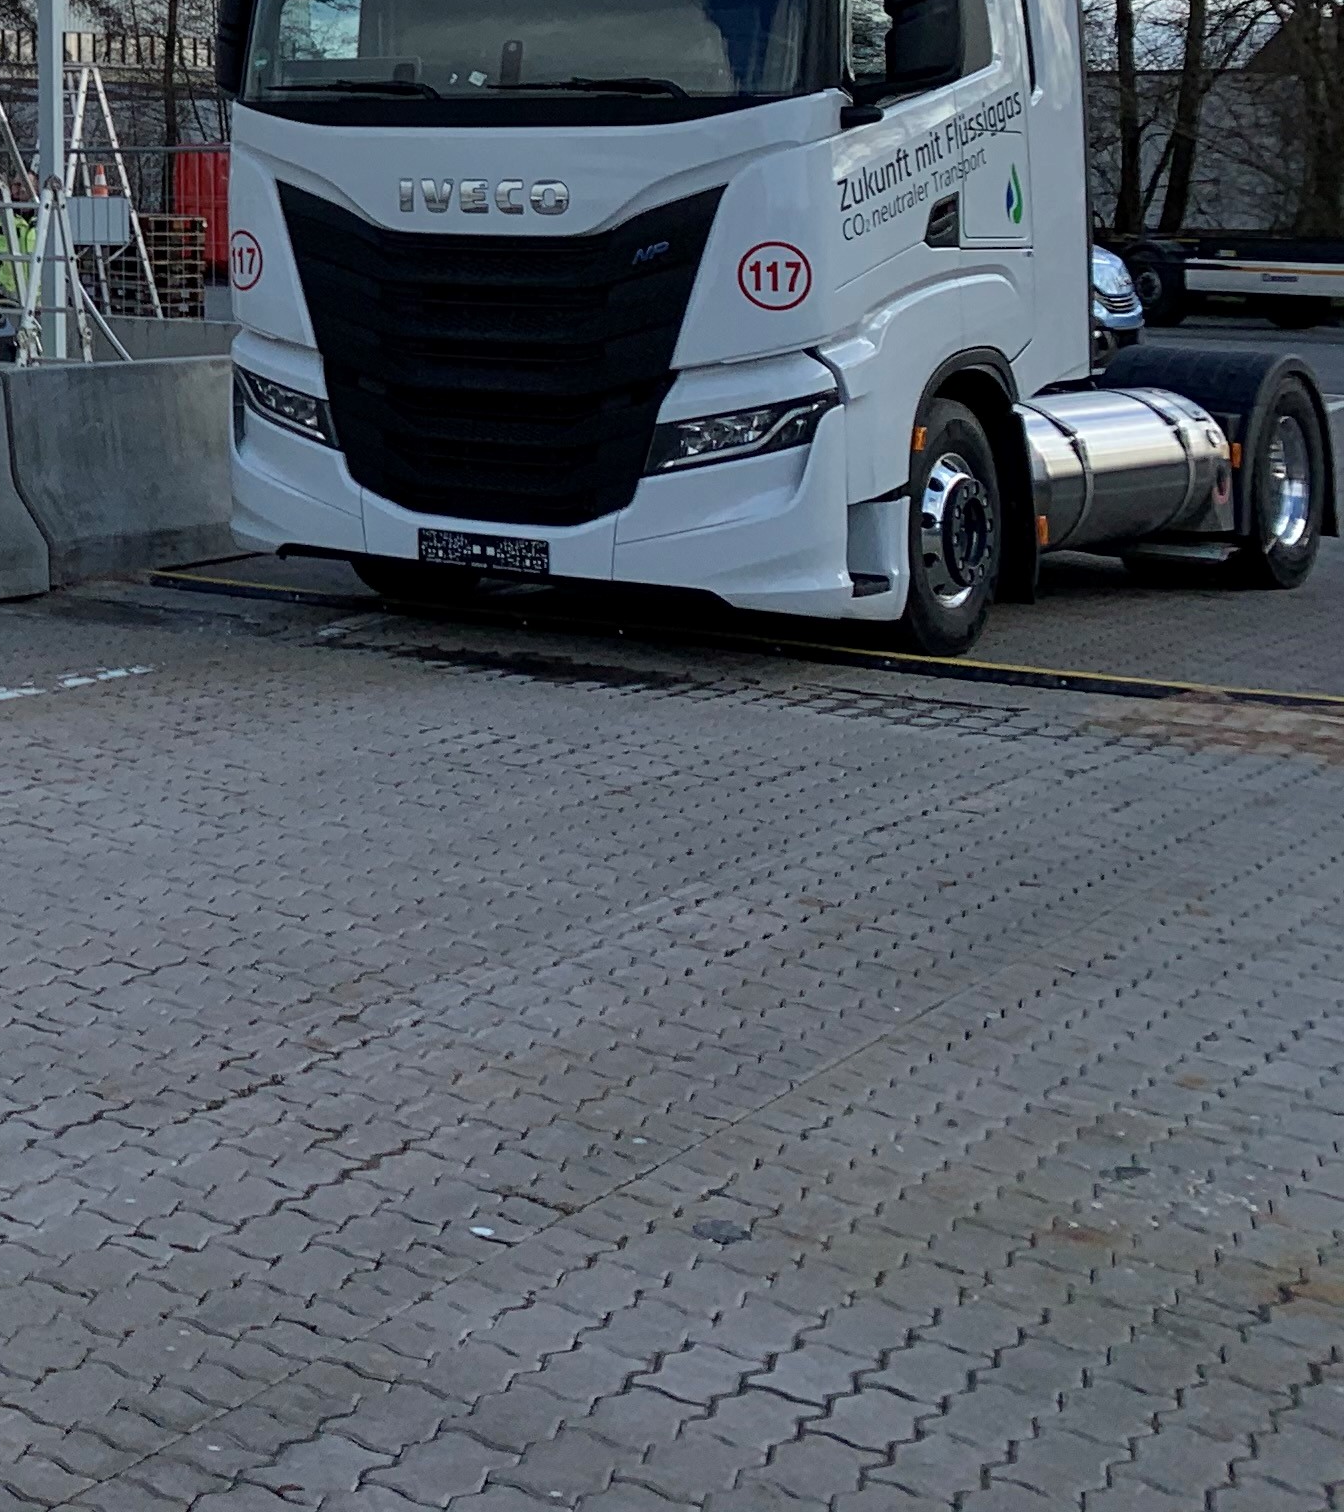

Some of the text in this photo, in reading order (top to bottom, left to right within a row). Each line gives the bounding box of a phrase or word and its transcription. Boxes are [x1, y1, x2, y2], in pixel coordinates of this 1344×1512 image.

[837, 91, 1022, 212] Zukunft mit Flüssiggas
[399, 178, 570, 215] IVECO
[872, 179, 930, 228] neutraler
[931, 148, 987, 192] Transport
[749, 260, 801, 293] 117
